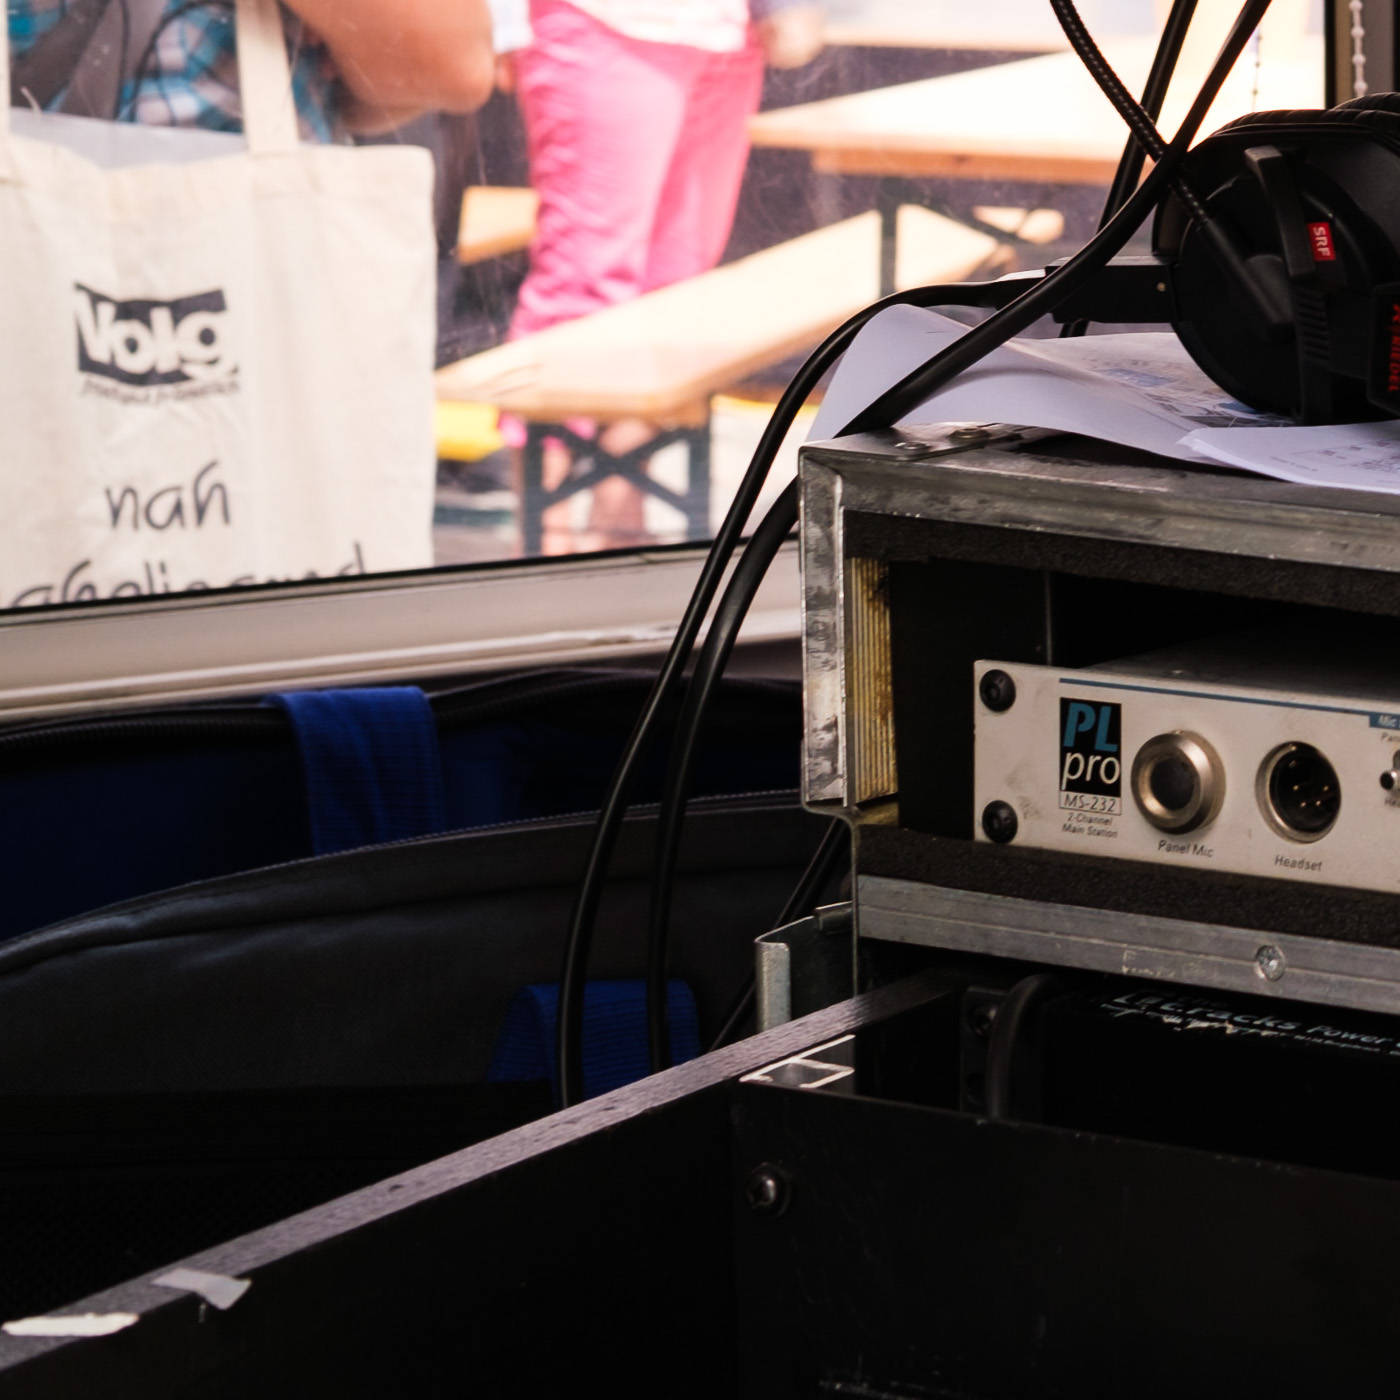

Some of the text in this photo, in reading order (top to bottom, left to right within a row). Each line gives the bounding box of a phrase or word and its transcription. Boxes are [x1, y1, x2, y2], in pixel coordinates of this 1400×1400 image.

[1313, 226, 1331, 257] SRF
[105, 459, 231, 531] nah
[1063, 701, 1118, 752] PL
[1378, 715, 1398, 728] Mic
[1061, 752, 1120, 791] pro
[1064, 793, 1117, 812] MS-232
[1067, 812, 1113, 825] 2-Channel
[1062, 823, 1118, 838] Main Station
[1158, 839, 1214, 858] Panel Mic
[1274, 854, 1323, 872] Headset
[1310, 1024, 1392, 1046] Power
